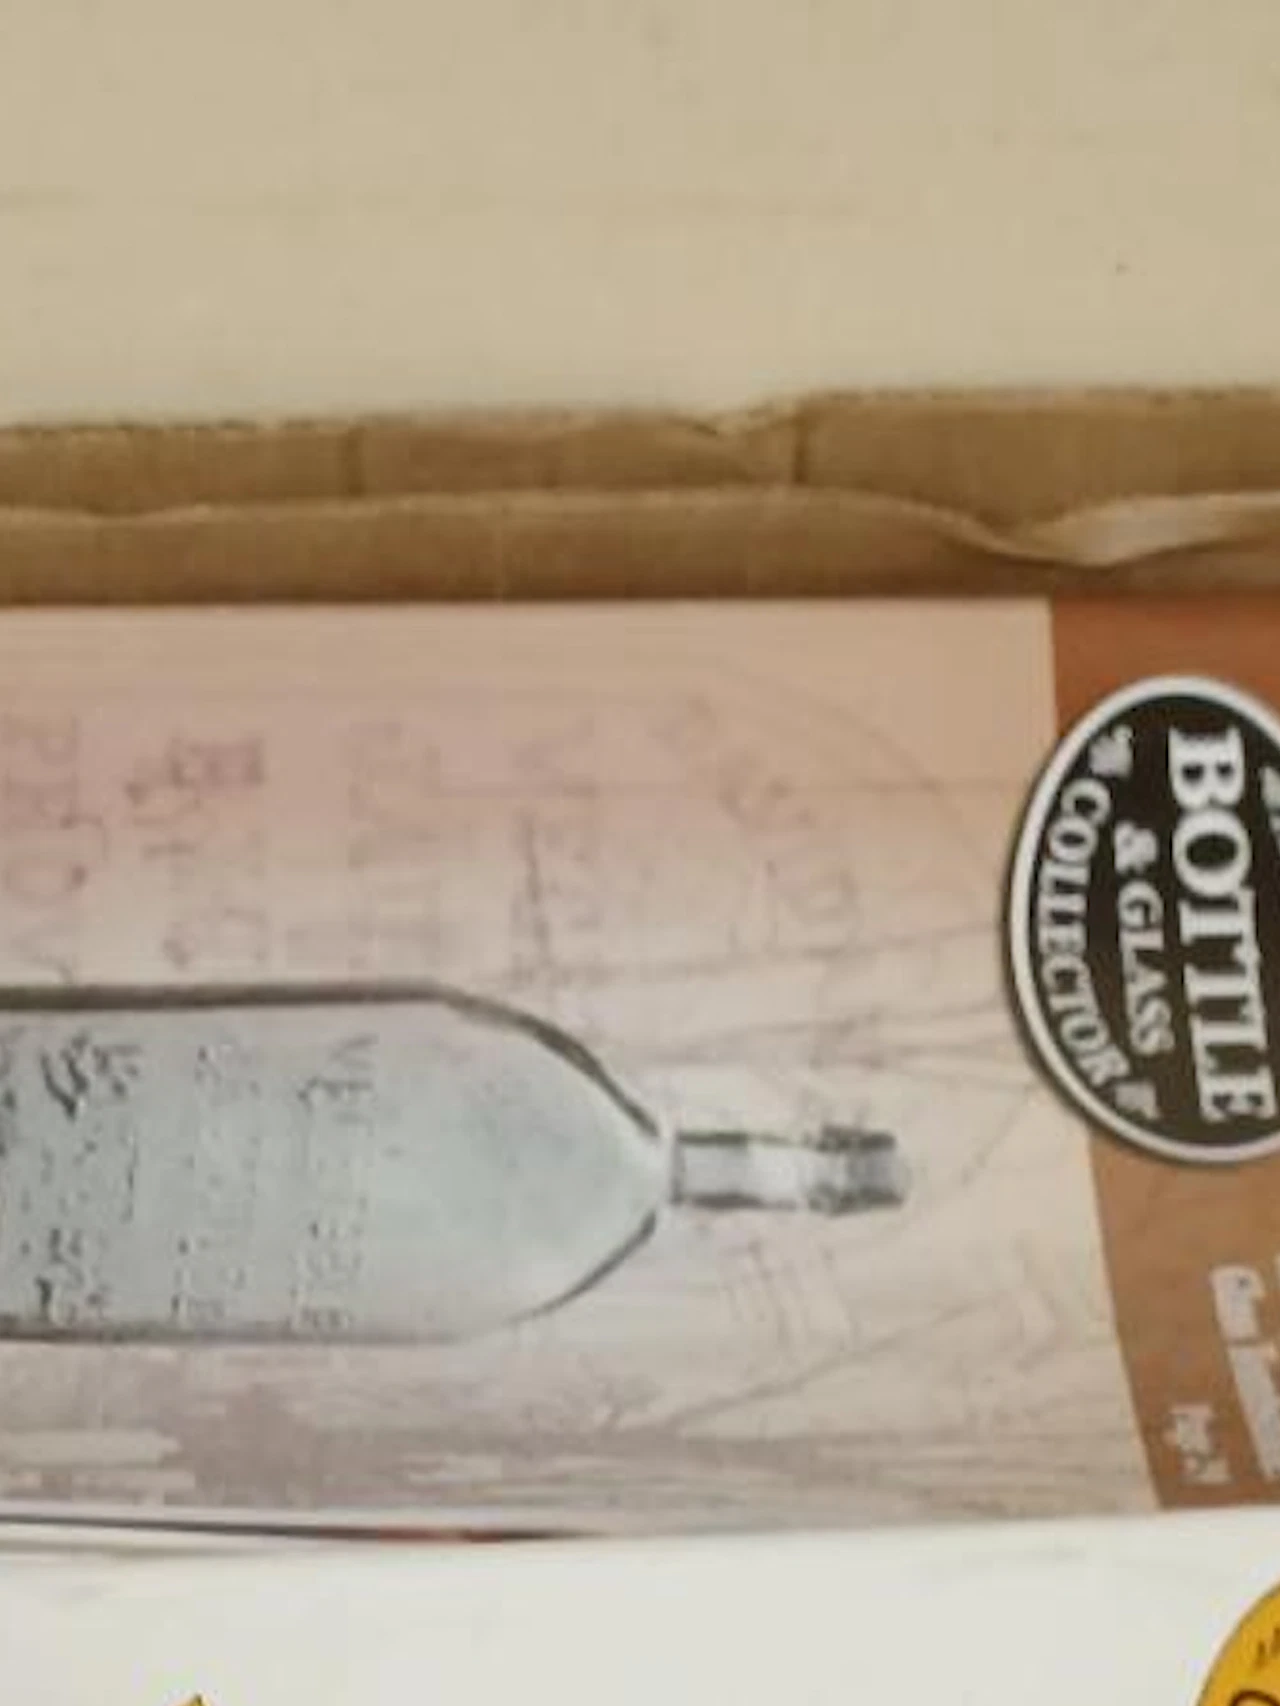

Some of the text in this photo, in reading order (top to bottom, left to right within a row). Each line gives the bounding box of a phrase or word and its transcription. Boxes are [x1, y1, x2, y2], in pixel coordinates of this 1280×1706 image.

[1038, 777, 1131, 1087] COLLECTOR
[1114, 820, 1176, 1055] & GLASS
[1167, 723, 1279, 1123] BOTTLE
